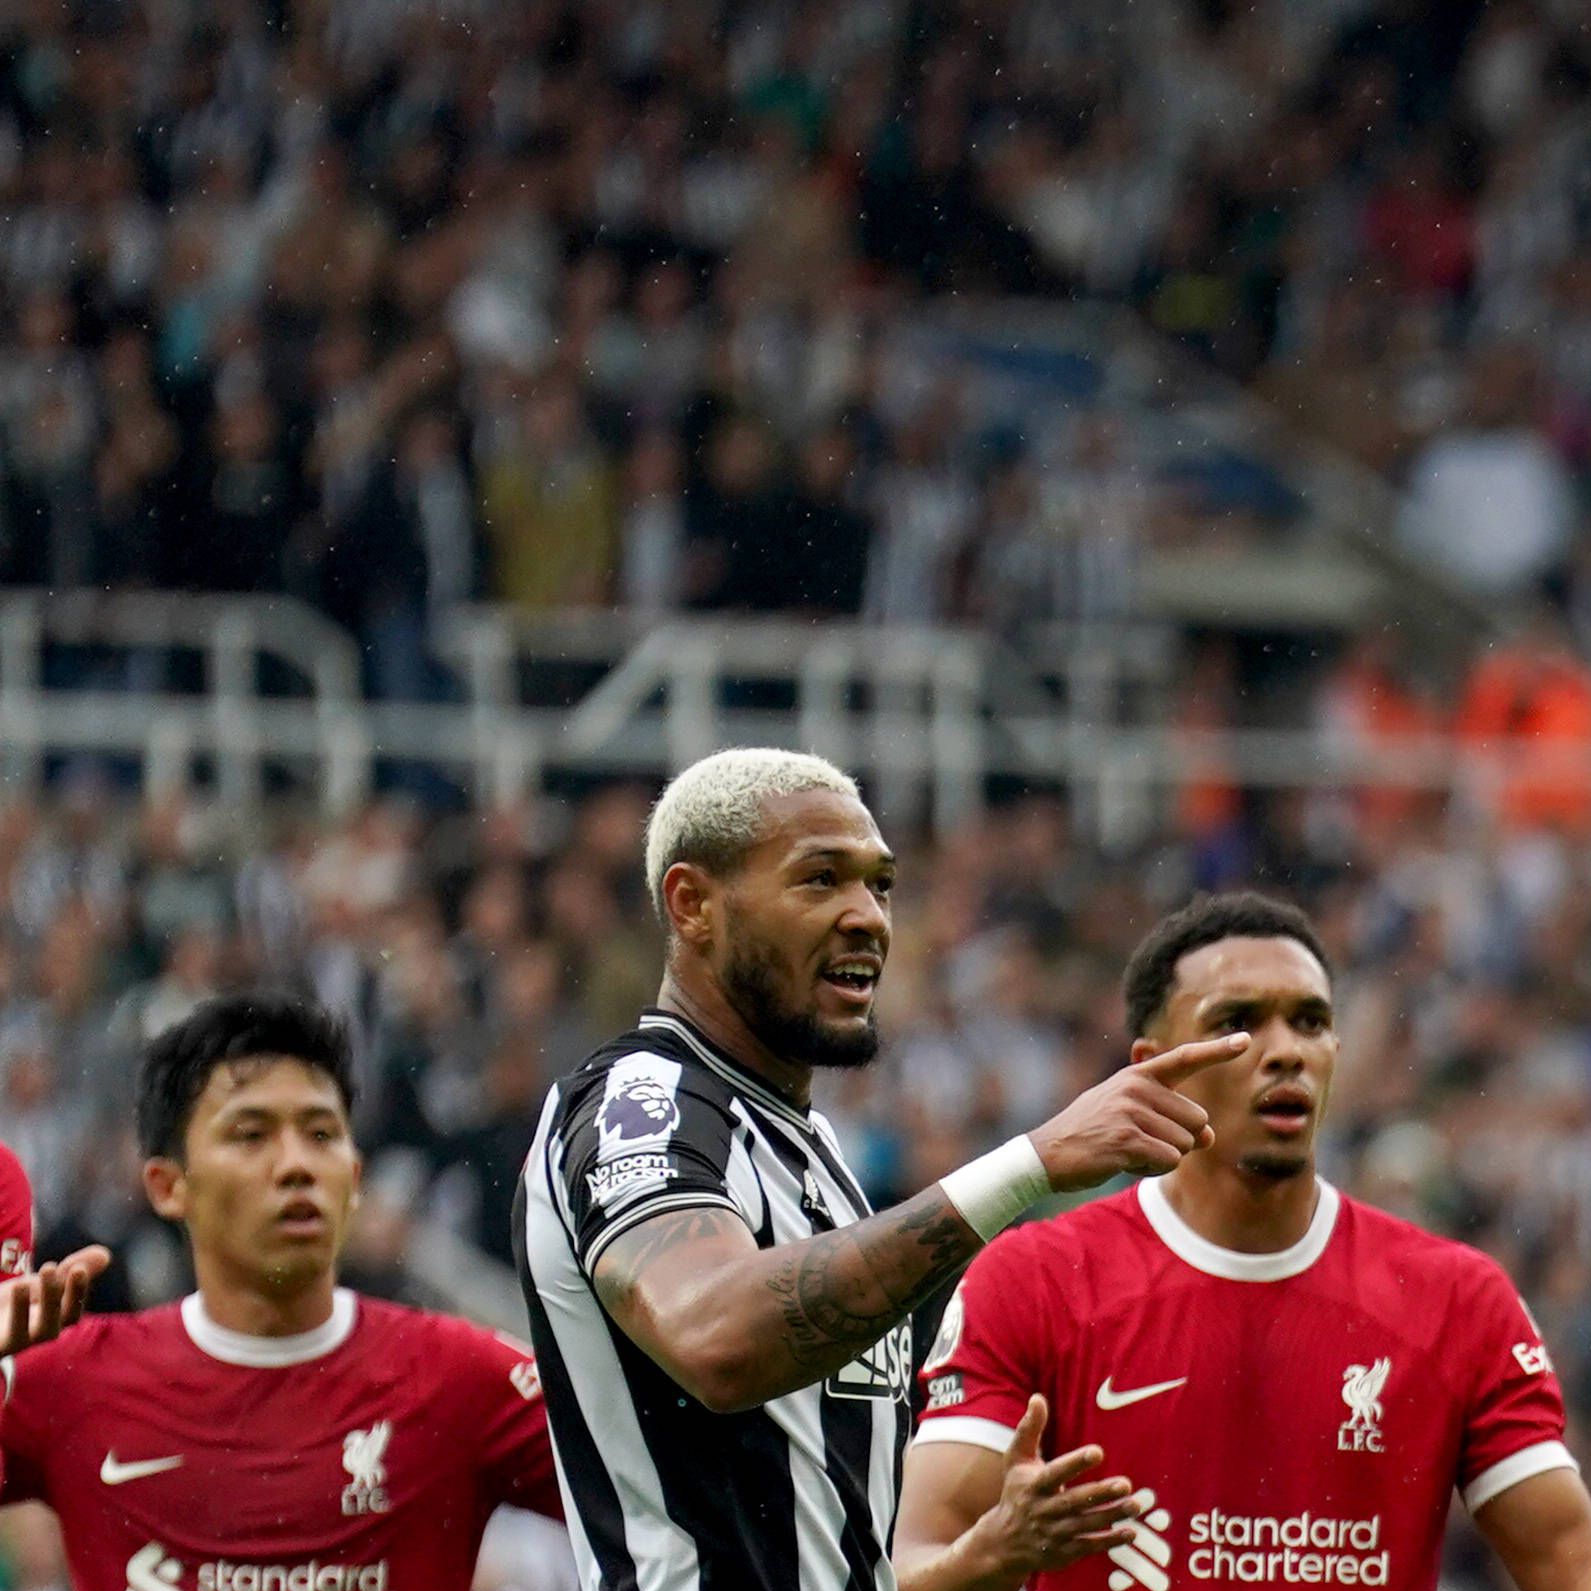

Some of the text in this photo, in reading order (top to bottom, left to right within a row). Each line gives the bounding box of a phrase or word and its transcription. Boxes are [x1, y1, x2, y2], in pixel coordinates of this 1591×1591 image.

[585, 1154, 669, 1187] No room
[1189, 1507, 1379, 1550] standard
[1188, 1545, 1389, 1586] chartered
